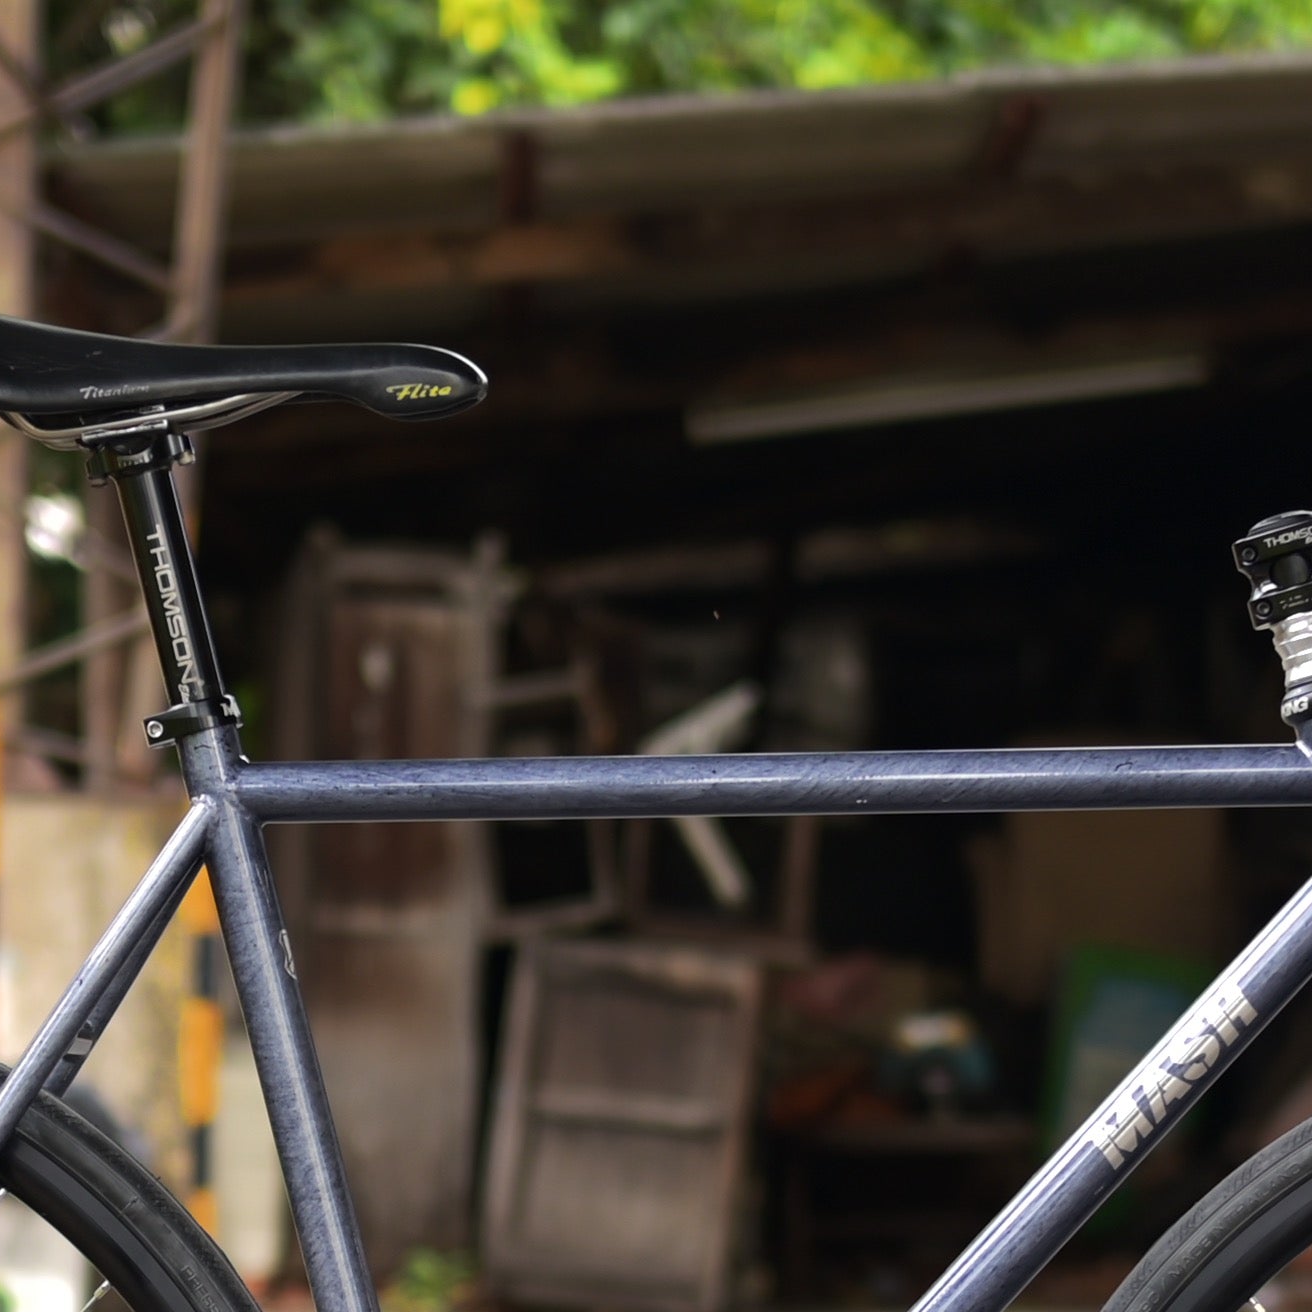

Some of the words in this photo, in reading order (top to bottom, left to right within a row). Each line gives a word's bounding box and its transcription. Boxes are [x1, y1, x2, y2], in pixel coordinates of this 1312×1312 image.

[386, 383, 452, 401] Flite
[146, 523, 197, 685] THOMSON
[1092, 980, 1259, 1170] MASH
